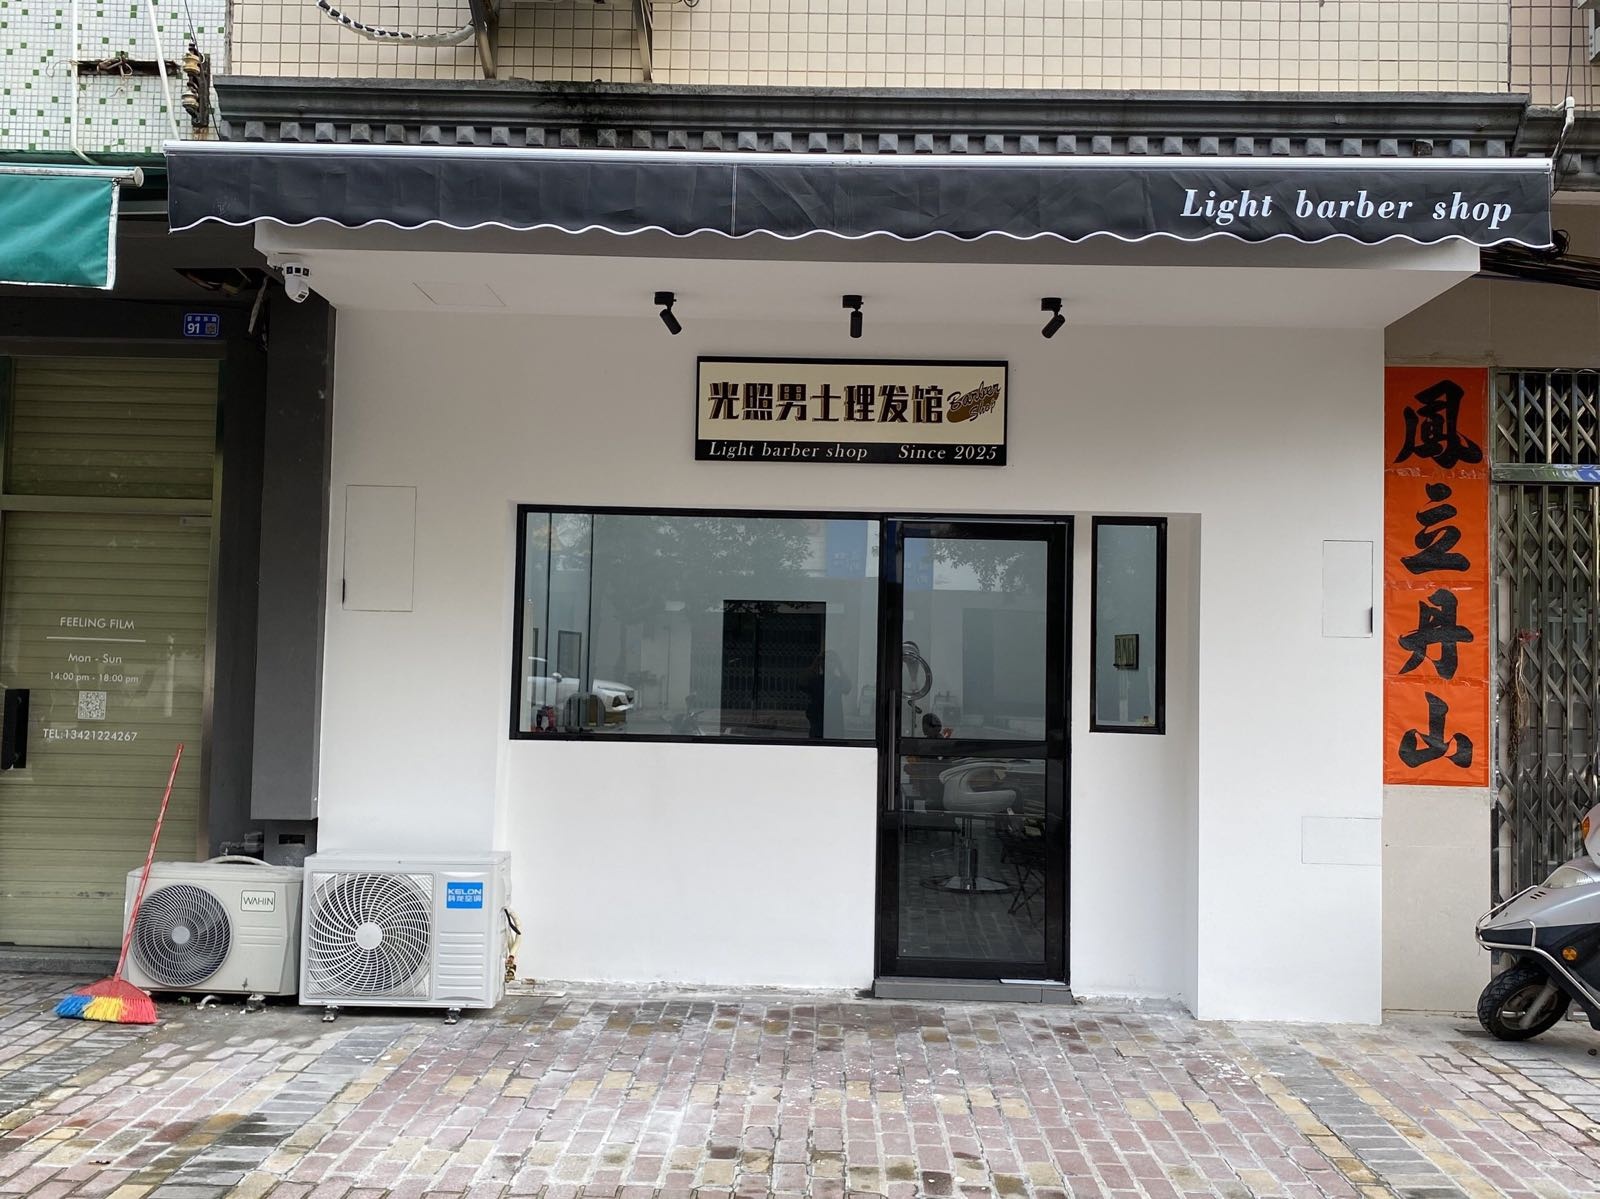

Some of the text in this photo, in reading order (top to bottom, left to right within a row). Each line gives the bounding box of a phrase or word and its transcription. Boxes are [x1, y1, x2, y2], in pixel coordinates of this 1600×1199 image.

[1180, 189, 1512, 230] Light barber shop
[187, 322, 200, 334] 91
[708, 382, 943, 424] 光照男士理发馆
[947, 380, 1001, 411] Barber
[709, 441, 868, 460] Light barber shop
[898, 444, 998, 460] Since 2025
[1394, 379, 1483, 769] 鳳立丹山
[60, 617, 135, 630] FEELING FILM
[68, 652, 92, 664] Mon
[102, 653, 123, 664] Sun
[50, 671, 74, 682] 14:00
[75, 674, 90, 684] pm
[99, 673, 124, 683] 18:00
[125, 675, 139, 685] pm
[43, 728, 138, 742] TEL:13421224267
[243, 896, 274, 905] WAHIN
